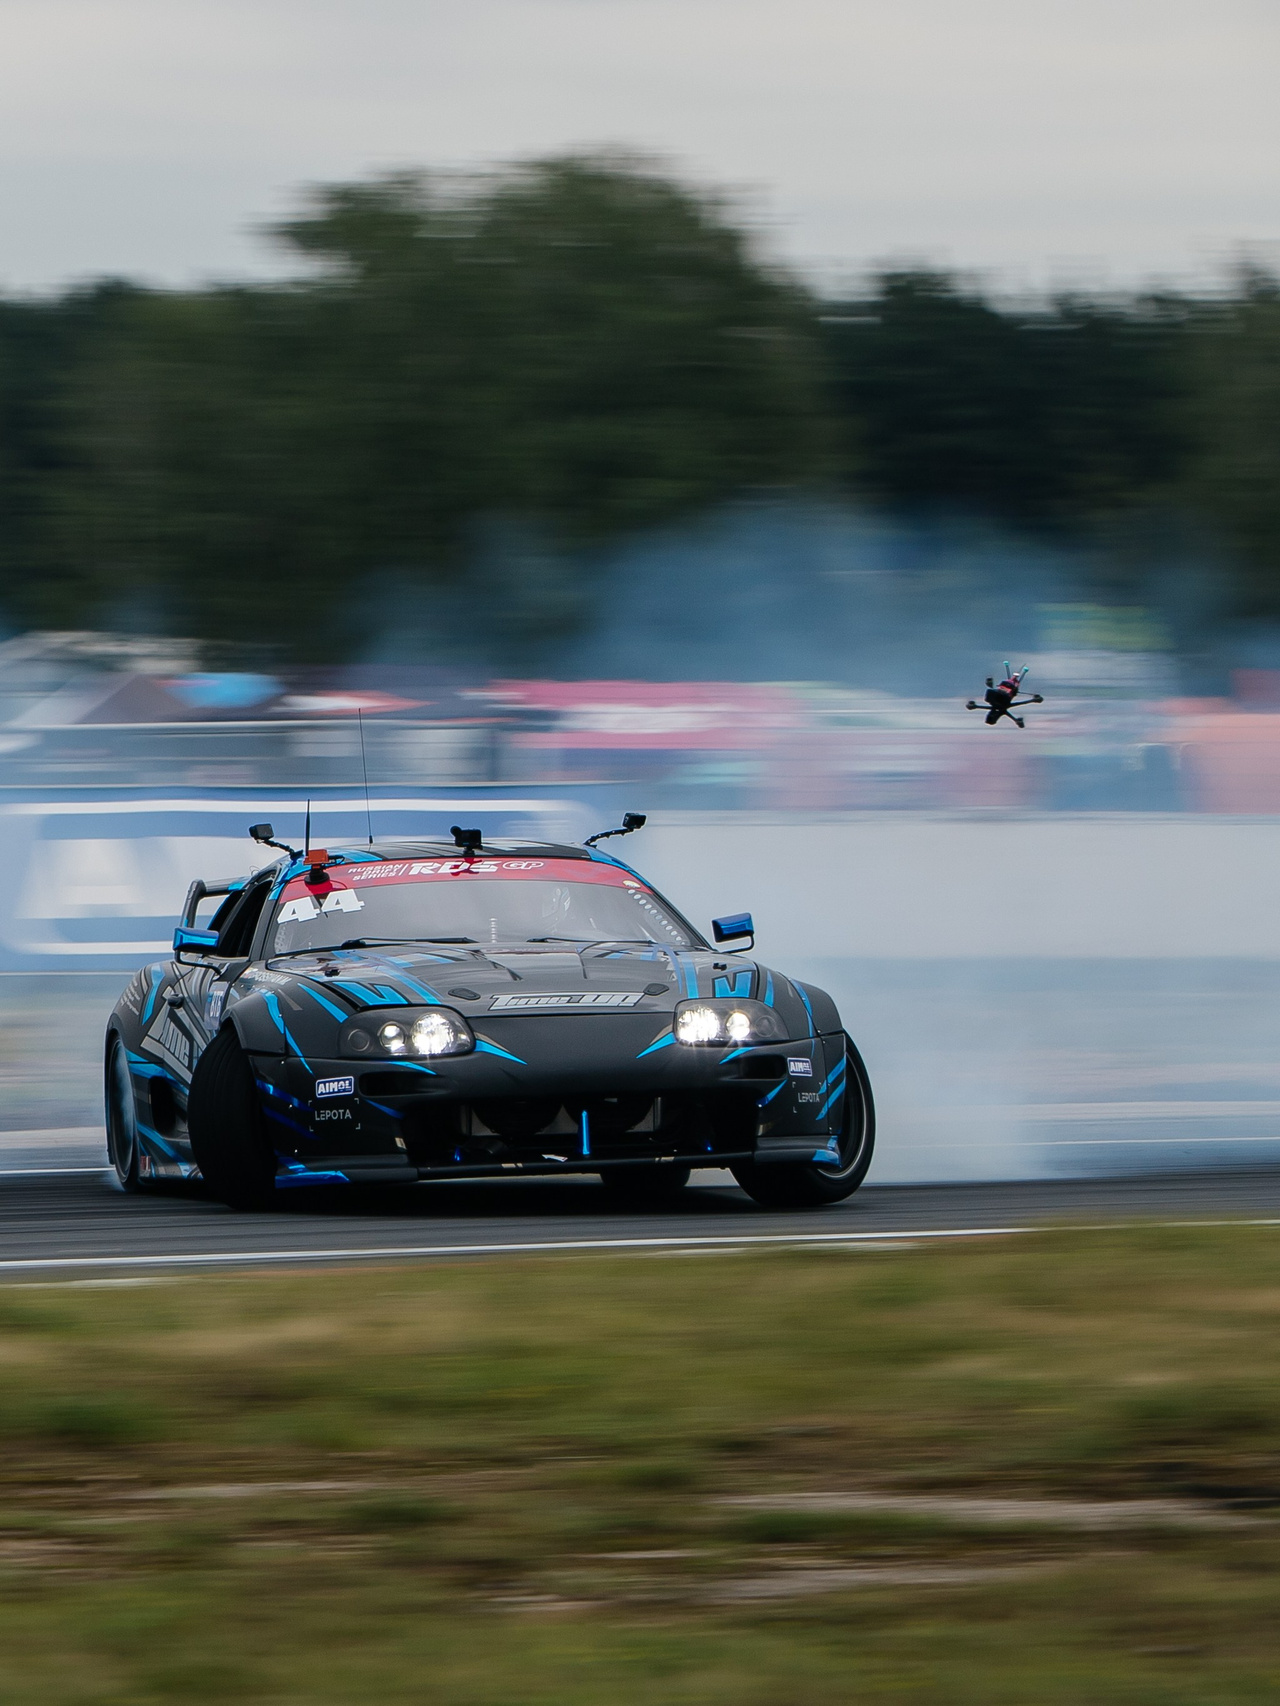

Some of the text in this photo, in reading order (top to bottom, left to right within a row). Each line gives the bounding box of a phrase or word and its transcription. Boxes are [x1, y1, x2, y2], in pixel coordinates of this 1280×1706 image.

[348, 863, 403, 874] RUSSIAN
[408, 860, 543, 876] RDS GP
[352, 871, 397, 881] SERIES
[277, 888, 366, 924] 44
[317, 1079, 352, 1095] AIMOL
[797, 1092, 821, 1103] LEPOTA
[314, 1109, 352, 1121] LEPOTA
